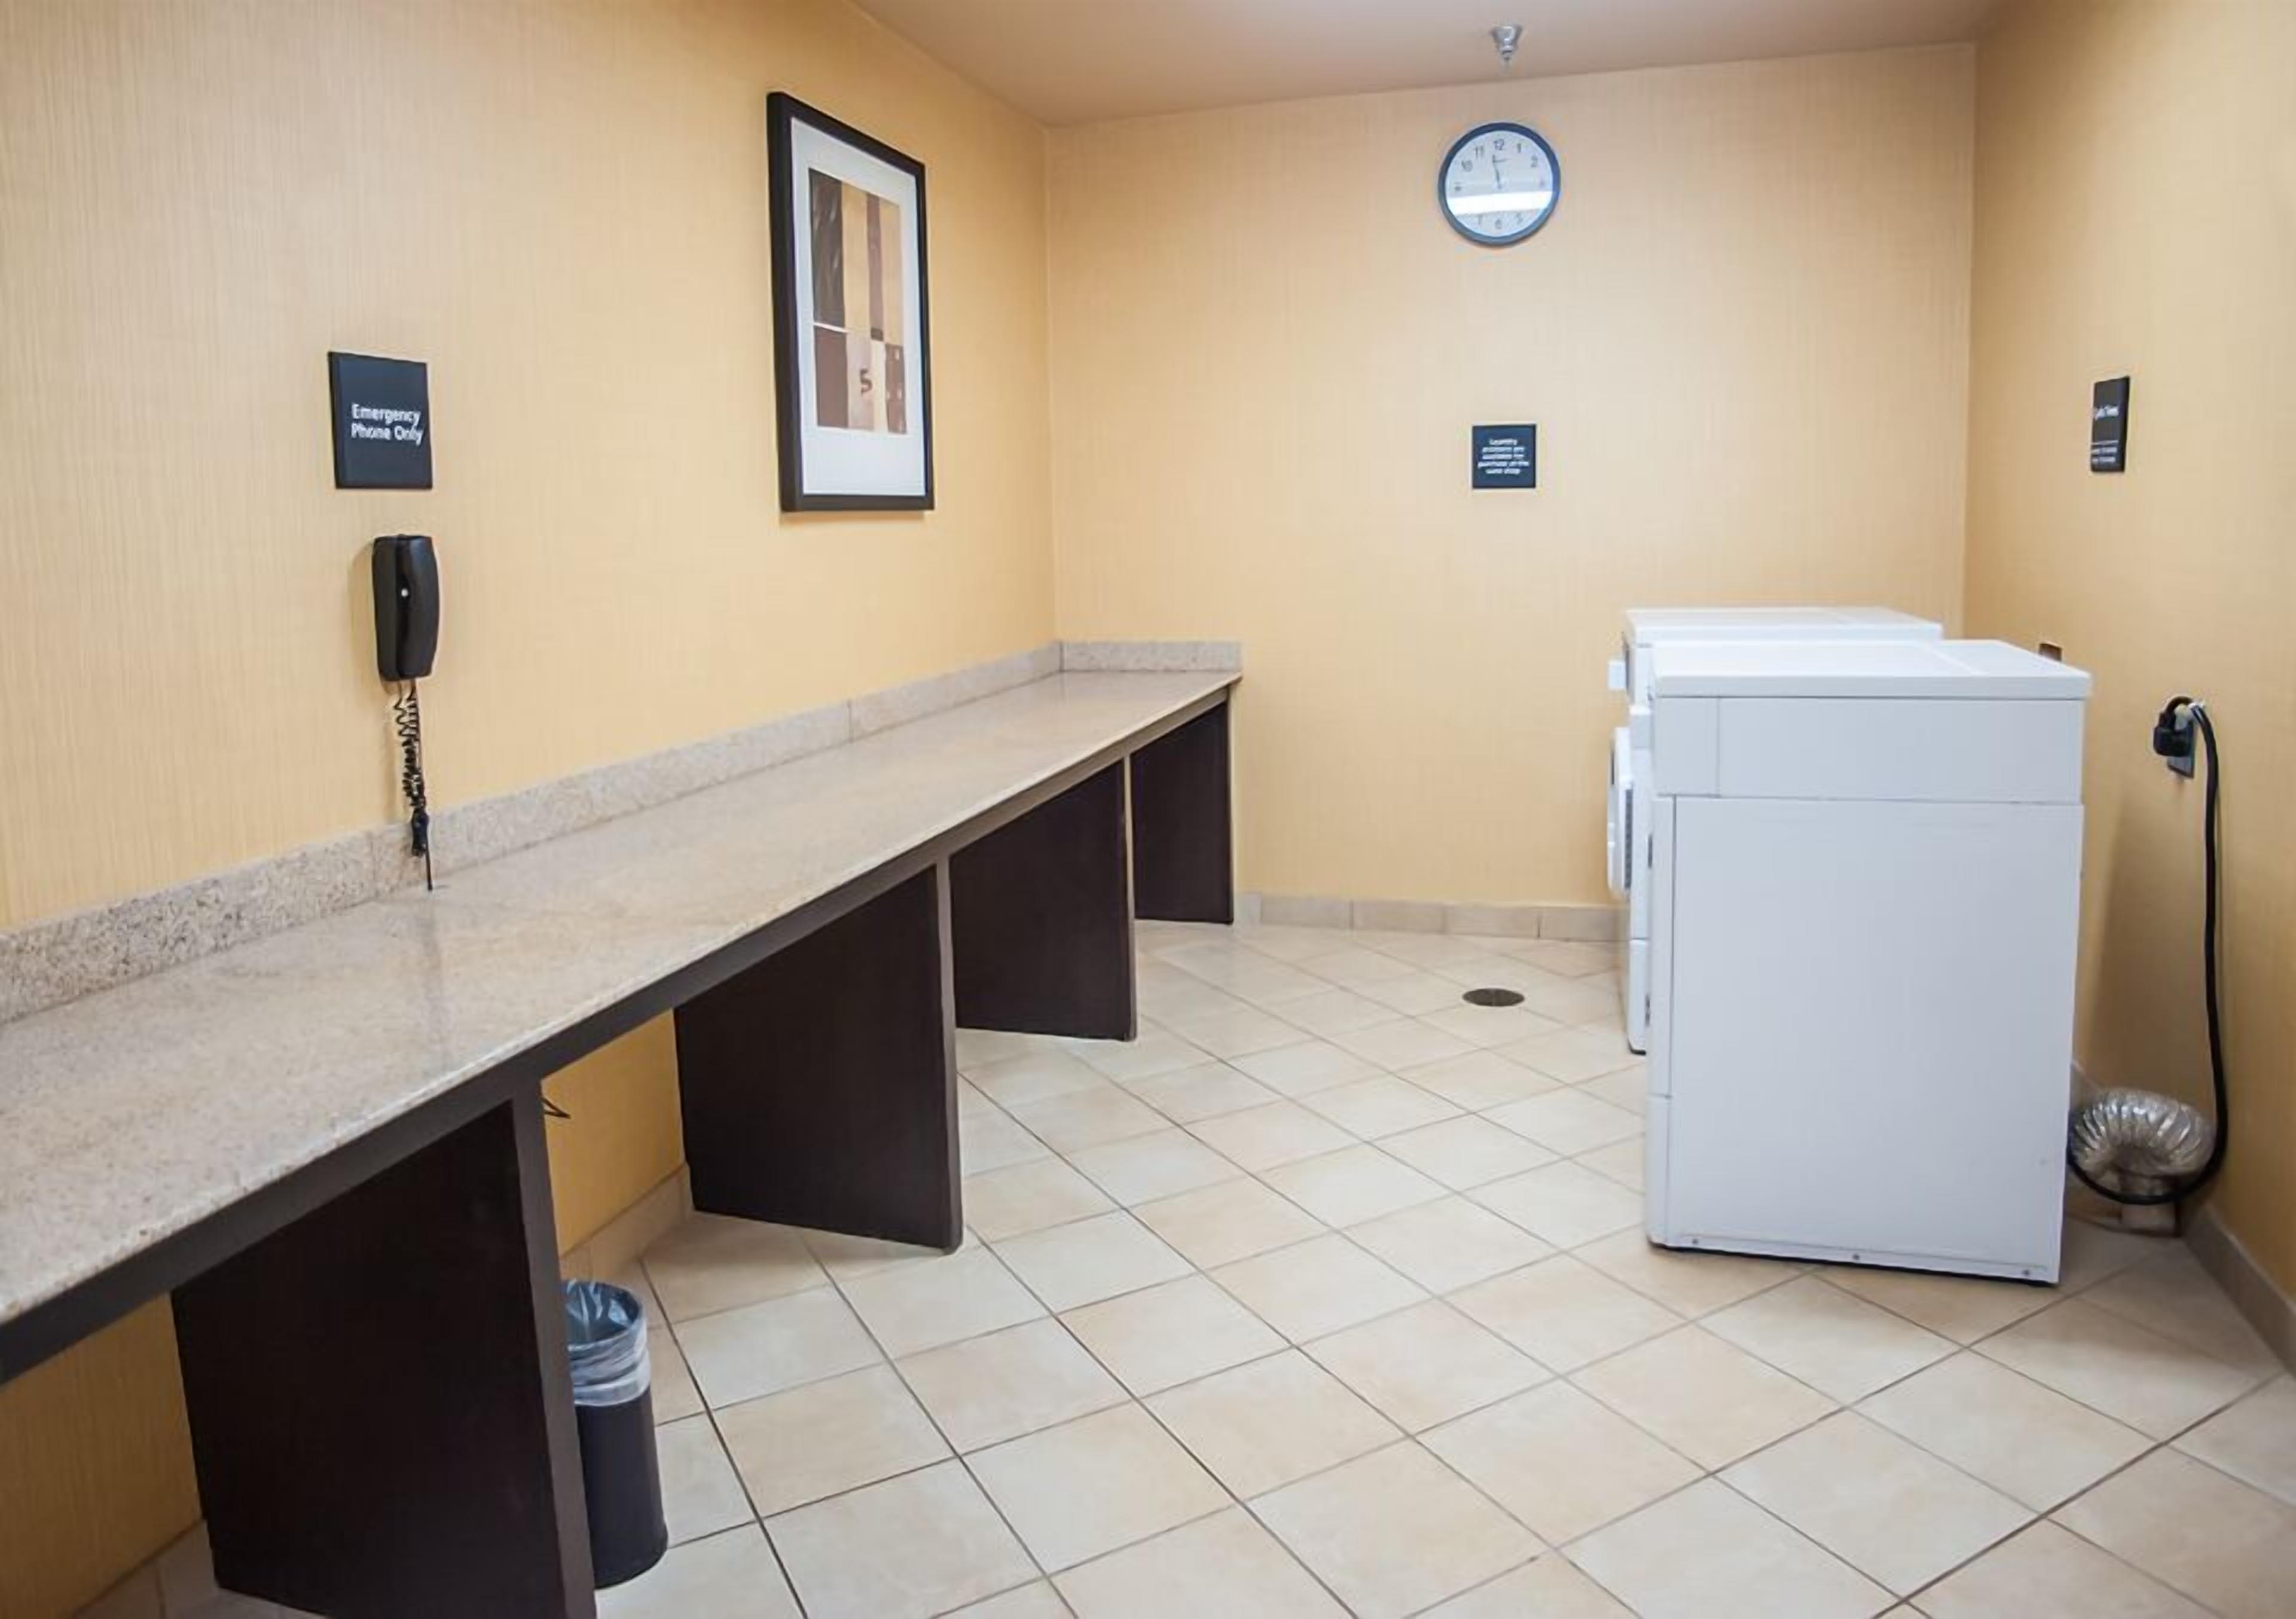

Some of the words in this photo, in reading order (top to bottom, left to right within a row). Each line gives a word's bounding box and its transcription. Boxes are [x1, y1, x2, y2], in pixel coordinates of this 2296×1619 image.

[1475, 145, 1484, 158] 11
[1493, 139, 1504, 151] 12
[351, 402, 422, 427] Emergency
[351, 423, 391, 441] Phone
[394, 425, 424, 447] Only
